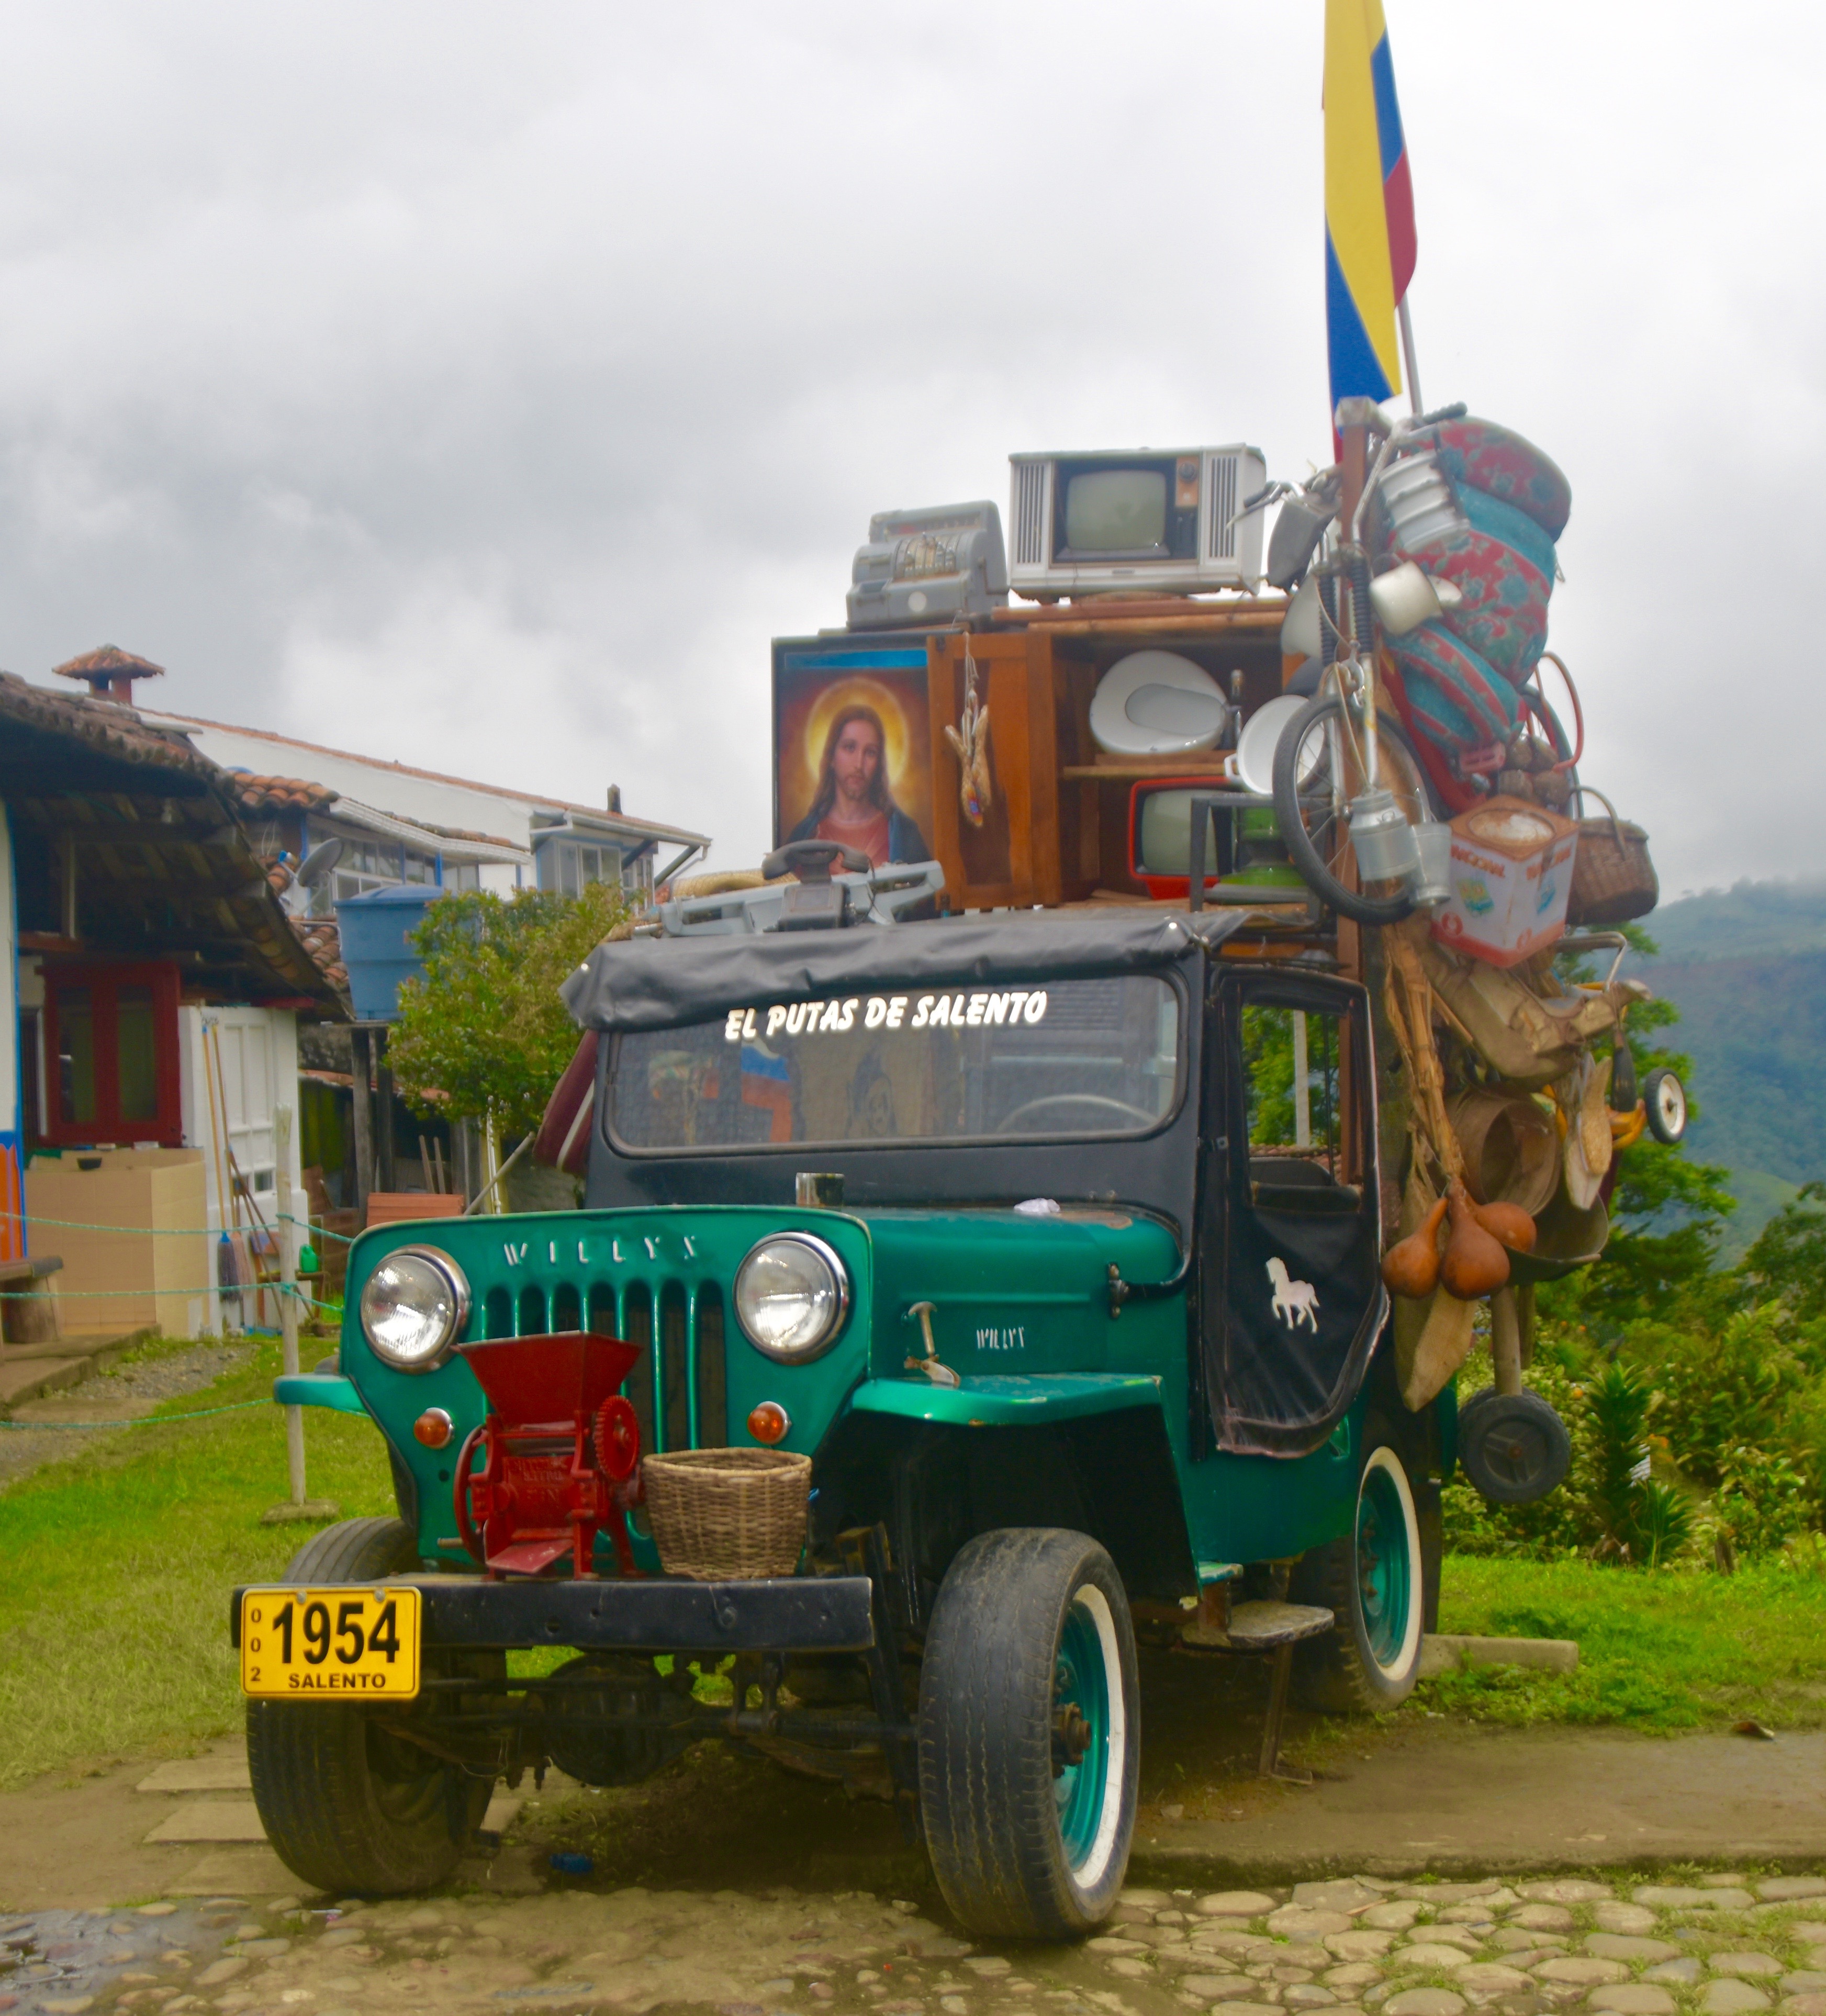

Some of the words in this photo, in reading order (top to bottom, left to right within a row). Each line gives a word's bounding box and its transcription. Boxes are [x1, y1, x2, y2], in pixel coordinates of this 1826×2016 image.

[725, 1008, 756, 1040] EL
[766, 998, 859, 1037] PUTAS
[865, 996, 908, 1027] DE
[911, 991, 1047, 1027] SALENTO
[272, 1599, 400, 1664] 1954
[288, 1672, 386, 1688] SALENTO
